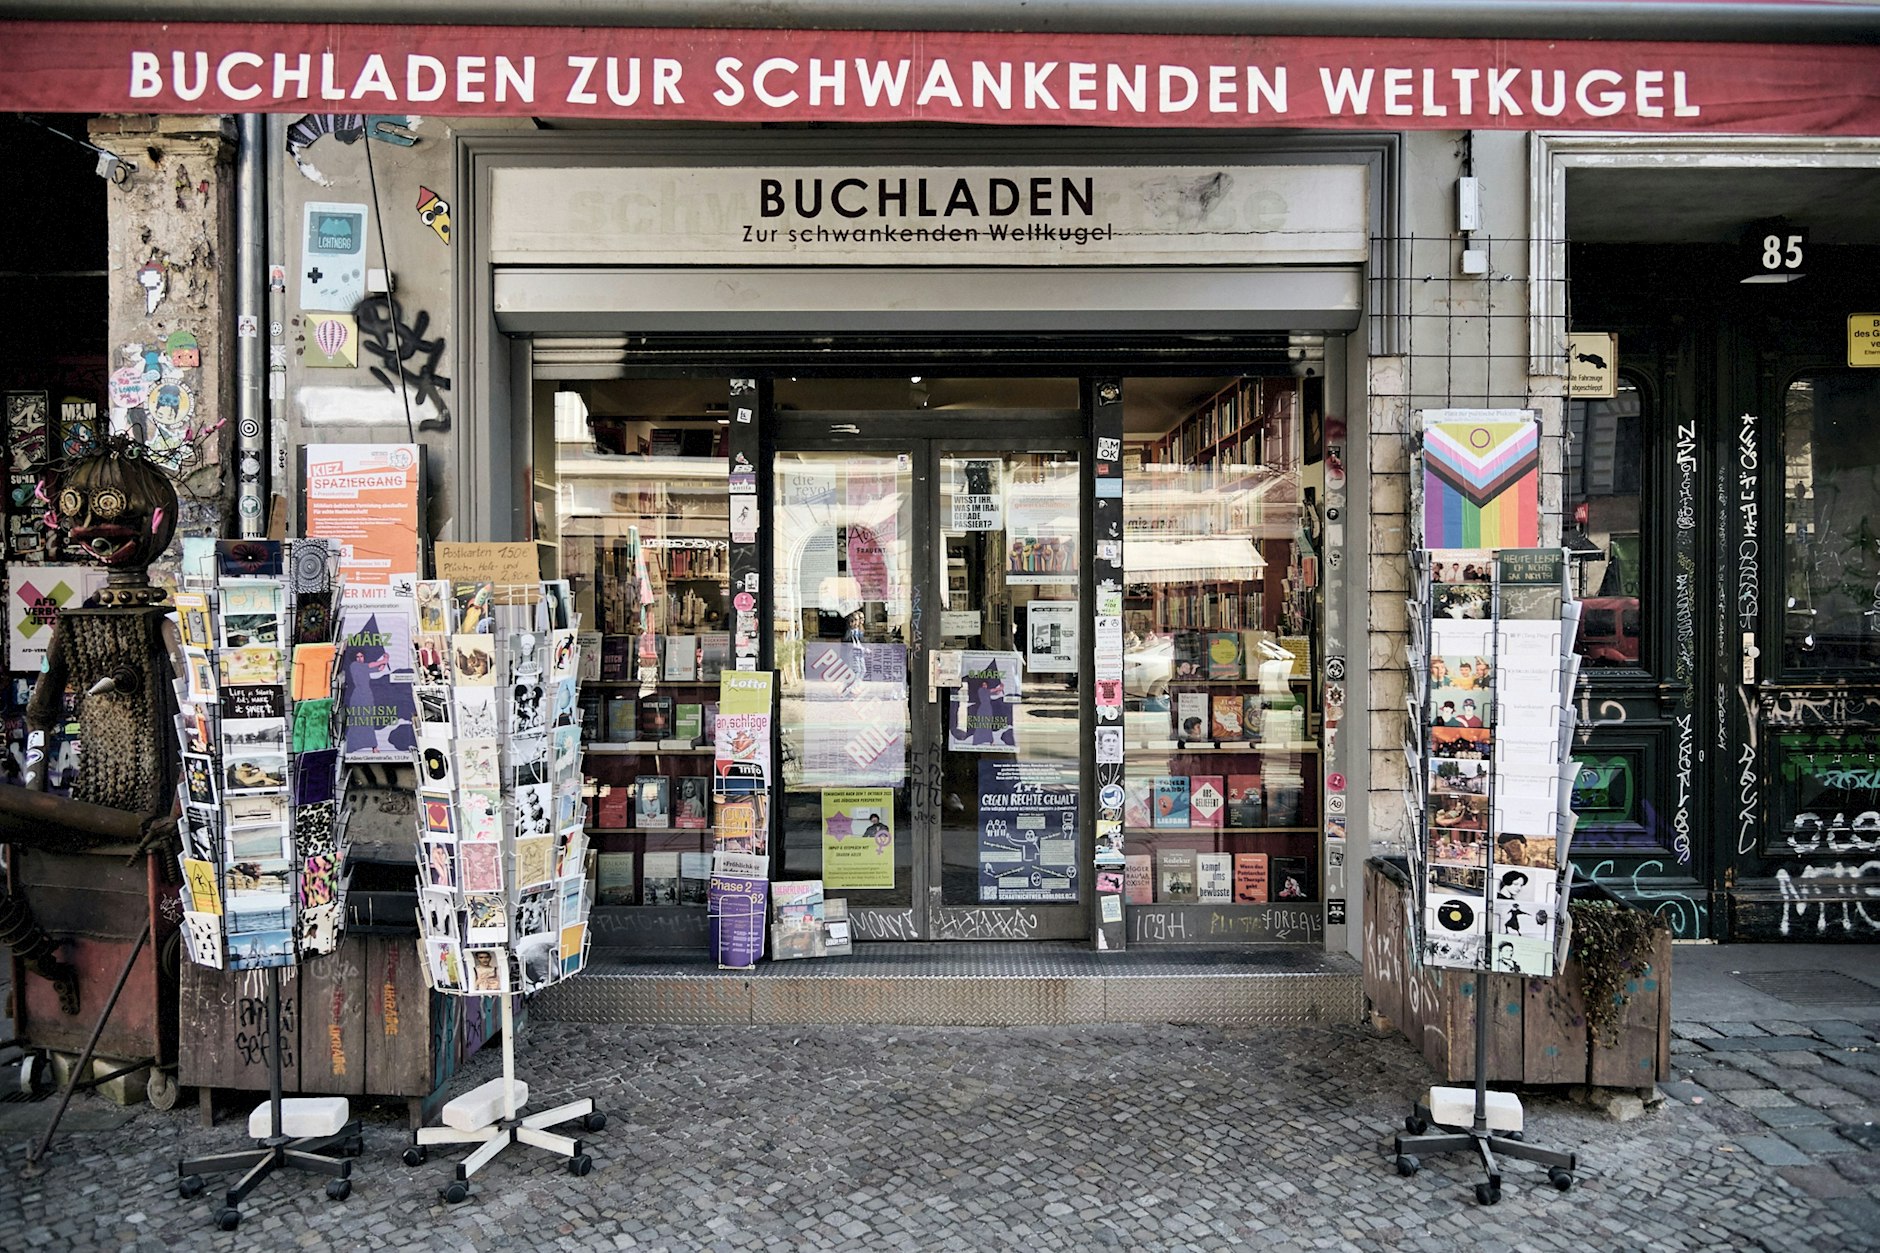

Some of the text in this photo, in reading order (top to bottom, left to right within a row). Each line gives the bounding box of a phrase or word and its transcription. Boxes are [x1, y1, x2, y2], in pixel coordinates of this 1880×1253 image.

[129, 50, 1701, 118] BUCHLADEN ZUR SCHWANKENDEN WELTKUGEL
[759, 177, 1095, 218] BUCHLADEN
[742, 223, 1114, 246] Zur schwankenden Weltkugel
[1762, 235, 1803, 269] 85
[1854, 329, 1870, 338] des
[1578, 374, 1603, 383] Fahrzeuge
[1572, 383, 1603, 392] abgeschleppt
[1101, 449, 1116, 459] OK
[312, 462, 340, 477] KIEZ
[314, 475, 403, 489] SPAZIERGANG
[792, 473, 815, 486] die
[953, 504, 999, 512] WAS IM IRAN
[954, 520, 993, 529] PASSIERT?
[443, 546, 491, 558] Postkarten
[1503, 554, 1560, 563] HEUTE LEISTE
[362, 588, 387, 598] MIT!
[34, 597, 57, 606] AFD
[730, 677, 767, 689] Lotta
[716, 714, 768, 730] an.schläge
[843, 720, 899, 769] RIDE
[982, 794, 1076, 806] GEGEN RECHTE GEWALT
[710, 878, 752, 893] Phase 2
[751, 893, 765, 904] 62
[1199, 888, 1230, 897] bewusste
[328, 1023, 347, 1075] UKRAINE
